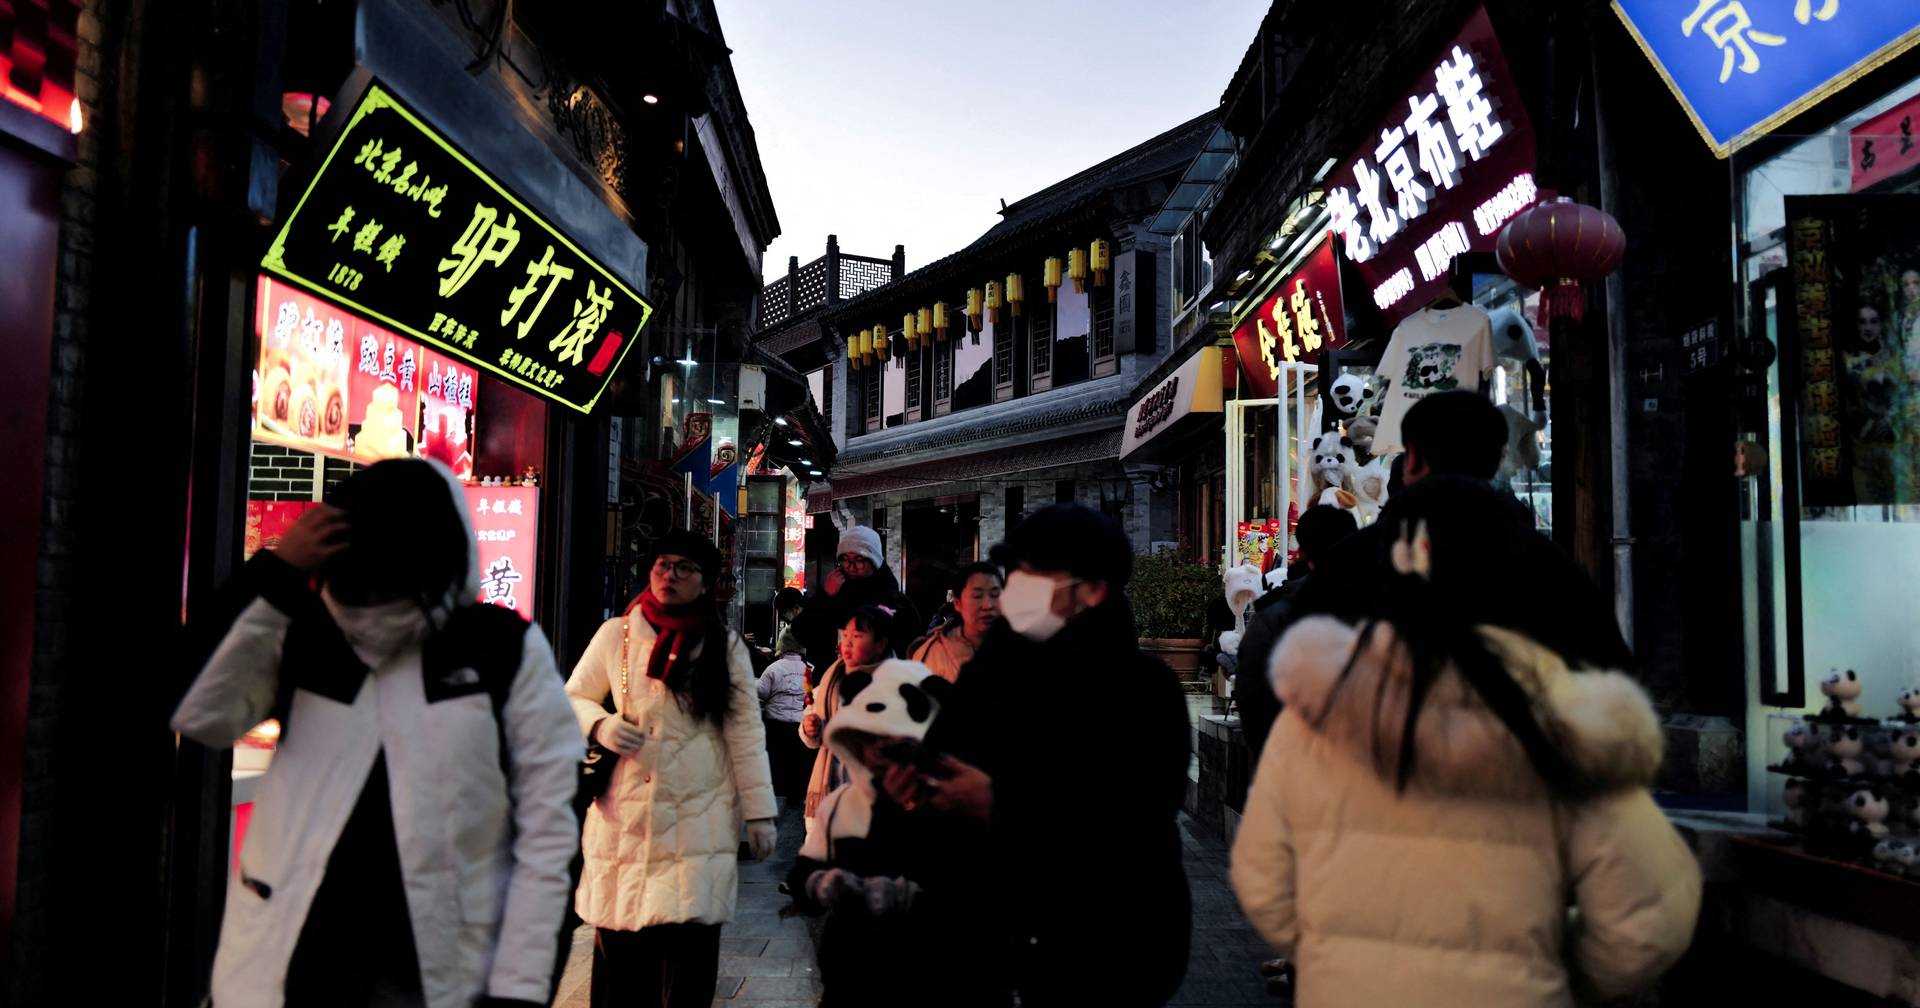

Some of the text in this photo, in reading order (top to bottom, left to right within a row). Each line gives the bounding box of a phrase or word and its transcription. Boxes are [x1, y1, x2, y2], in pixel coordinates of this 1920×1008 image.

[354, 138, 448, 218] 北京名小吃
[1325, 45, 1504, 264] 老北京布鞋
[327, 262, 364, 291] 1878
[438, 201, 615, 377] 驴打滚
[359, 333, 416, 393] 豌豆黄
